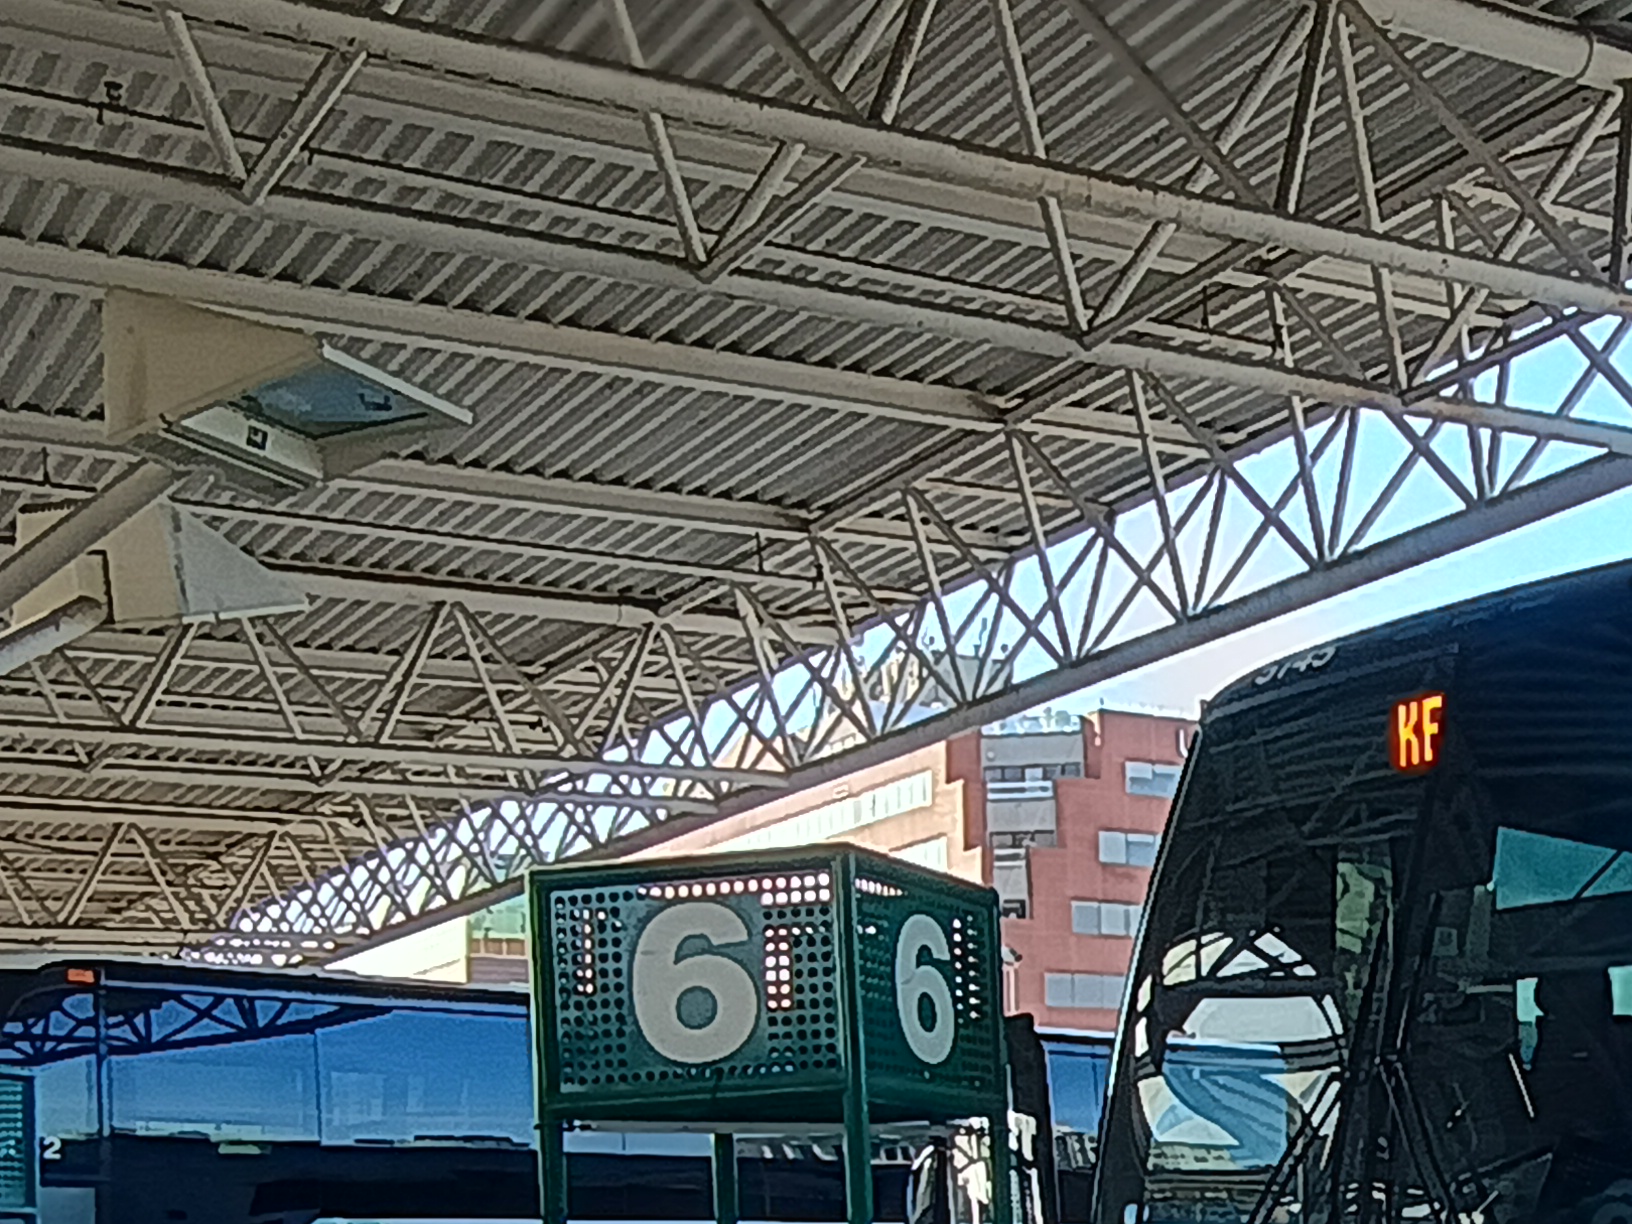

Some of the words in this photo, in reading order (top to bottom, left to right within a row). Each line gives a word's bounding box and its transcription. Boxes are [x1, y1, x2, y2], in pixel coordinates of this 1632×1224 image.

[1398, 695, 1442, 767] KF
[633, 903, 758, 1064] 6
[895, 913, 955, 1064] 6
